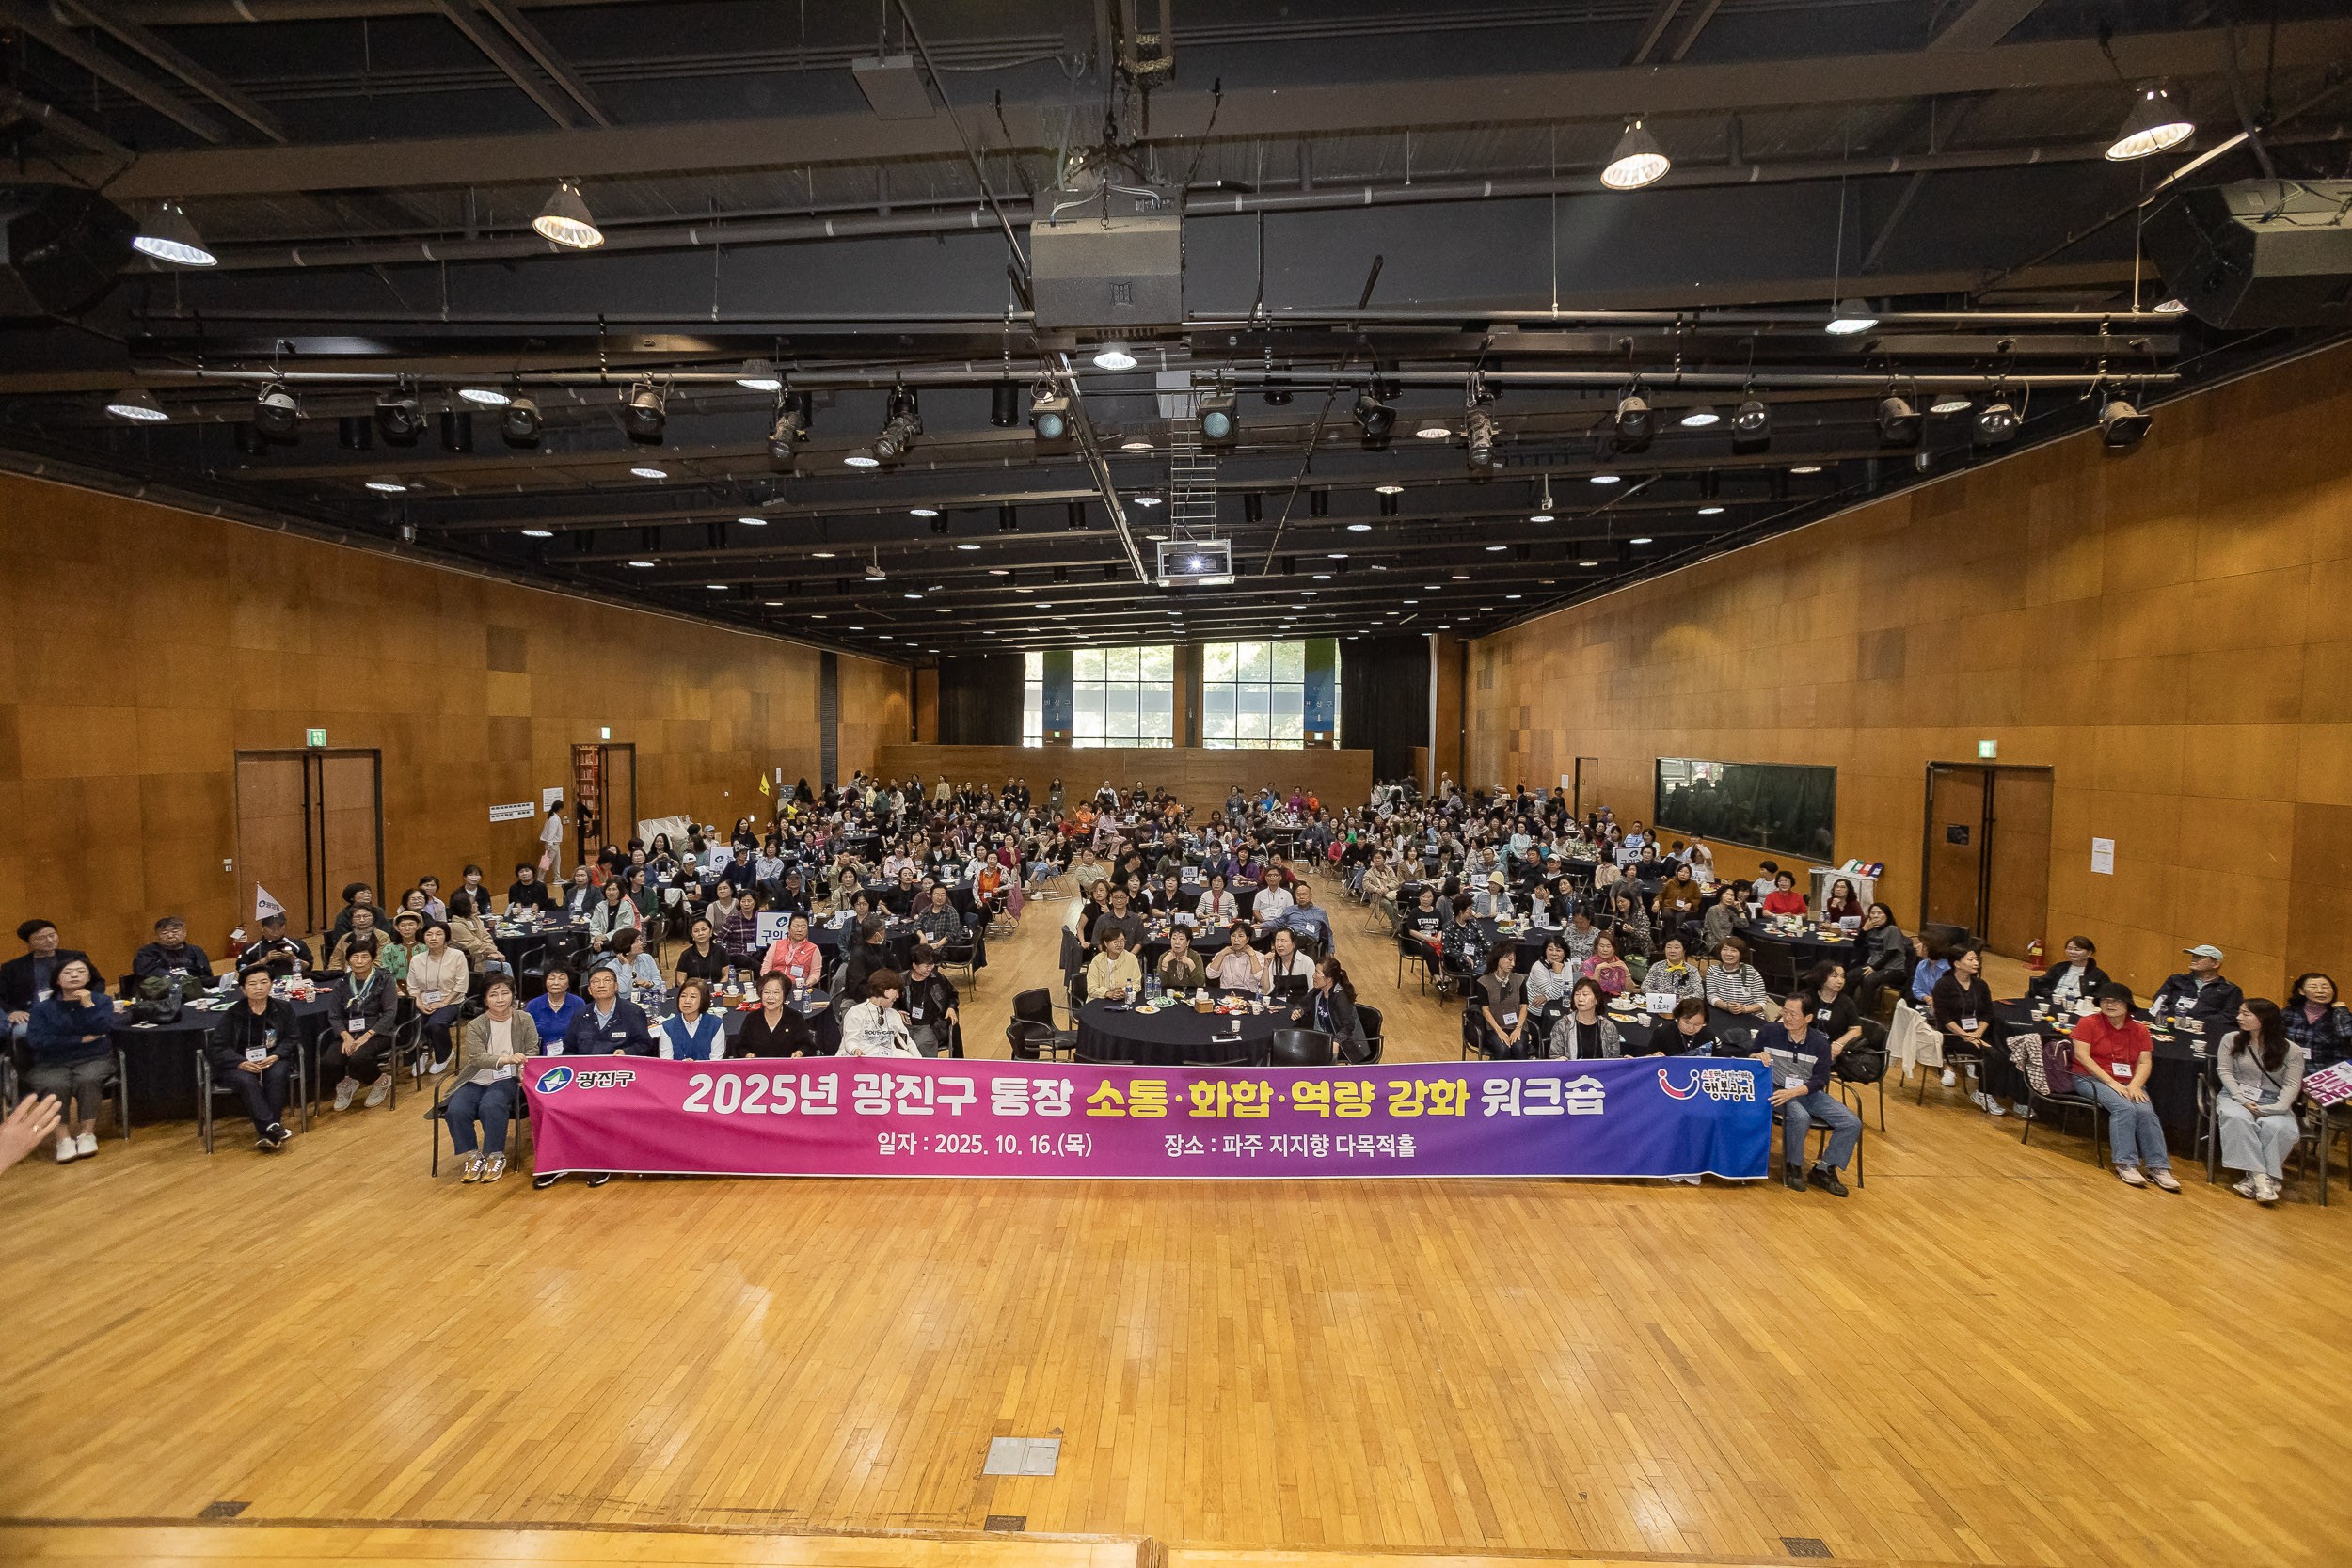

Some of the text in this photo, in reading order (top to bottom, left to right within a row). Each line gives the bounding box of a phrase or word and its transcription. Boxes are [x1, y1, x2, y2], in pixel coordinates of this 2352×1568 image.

[576, 1070, 635, 1088] 광진구
[1704, 1080, 1754, 1100] 행복광진
[682, 1072, 839, 1117] 2025년
[851, 1073, 977, 1117] 광진구
[990, 1076, 1075, 1117] 통장
[1388, 1078, 1471, 1117] 강화
[1480, 1074, 1606, 1117] 워크숍
[877, 1132, 917, 1156] 일자
[935, 1134, 989, 1156] 2025.
[995, 1135, 1023, 1156] 10.
[1028, 1133, 1093, 1159] 16.(목)
[1164, 1133, 1205, 1158] 장소
[1222, 1133, 1263, 1158] 파주
[1268, 1133, 1330, 1158] 지지향
[1335, 1133, 1418, 1158] 다목적홀
